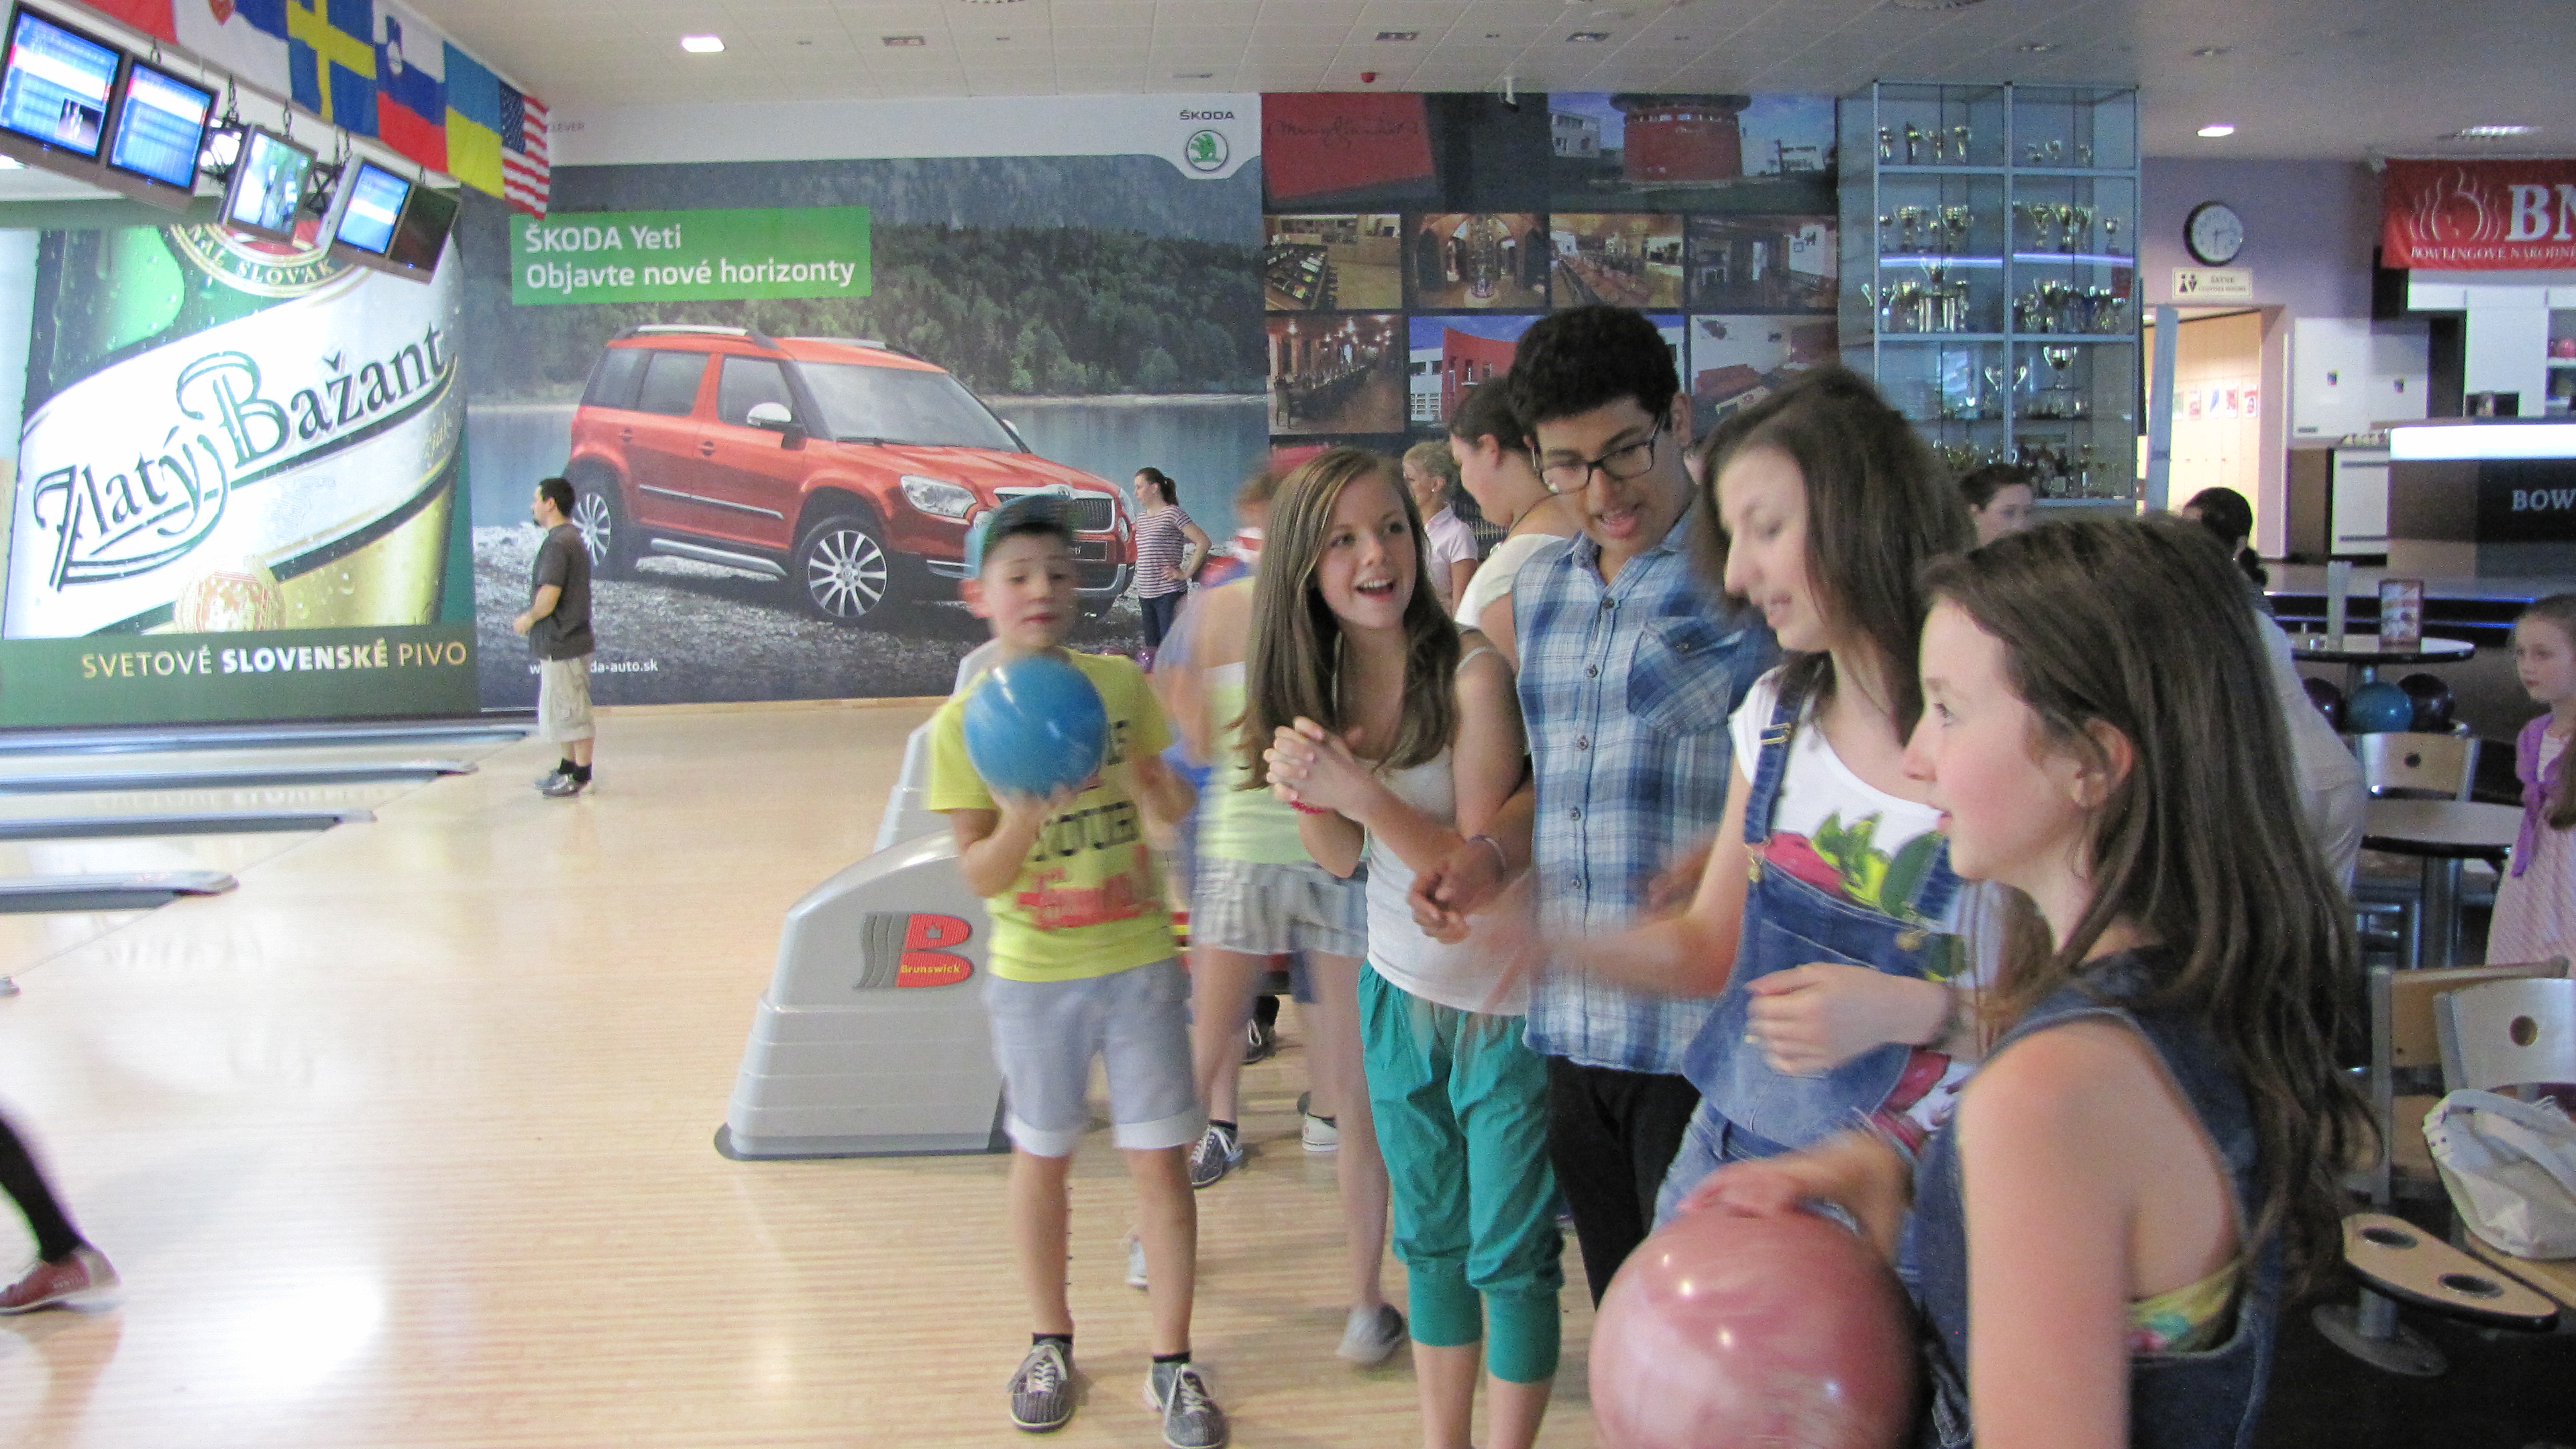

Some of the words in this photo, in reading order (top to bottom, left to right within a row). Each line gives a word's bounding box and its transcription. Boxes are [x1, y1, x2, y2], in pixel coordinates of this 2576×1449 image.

[1180, 110, 1235, 120] ŠKODA
[525, 225, 622, 253] ŠKODA
[630, 223, 682, 250] Yeti
[526, 262, 635, 294] Objavte
[643, 260, 712, 284] nové
[720, 258, 856, 287] horizonty
[34, 425, 229, 593] Zlatý
[176, 322, 447, 470] Bažant
[81, 645, 212, 679] SVETOVÉ
[221, 638, 389, 674] SLOVENSKÉ
[398, 641, 468, 666] PIVO
[901, 965, 961, 973] Brunswick
